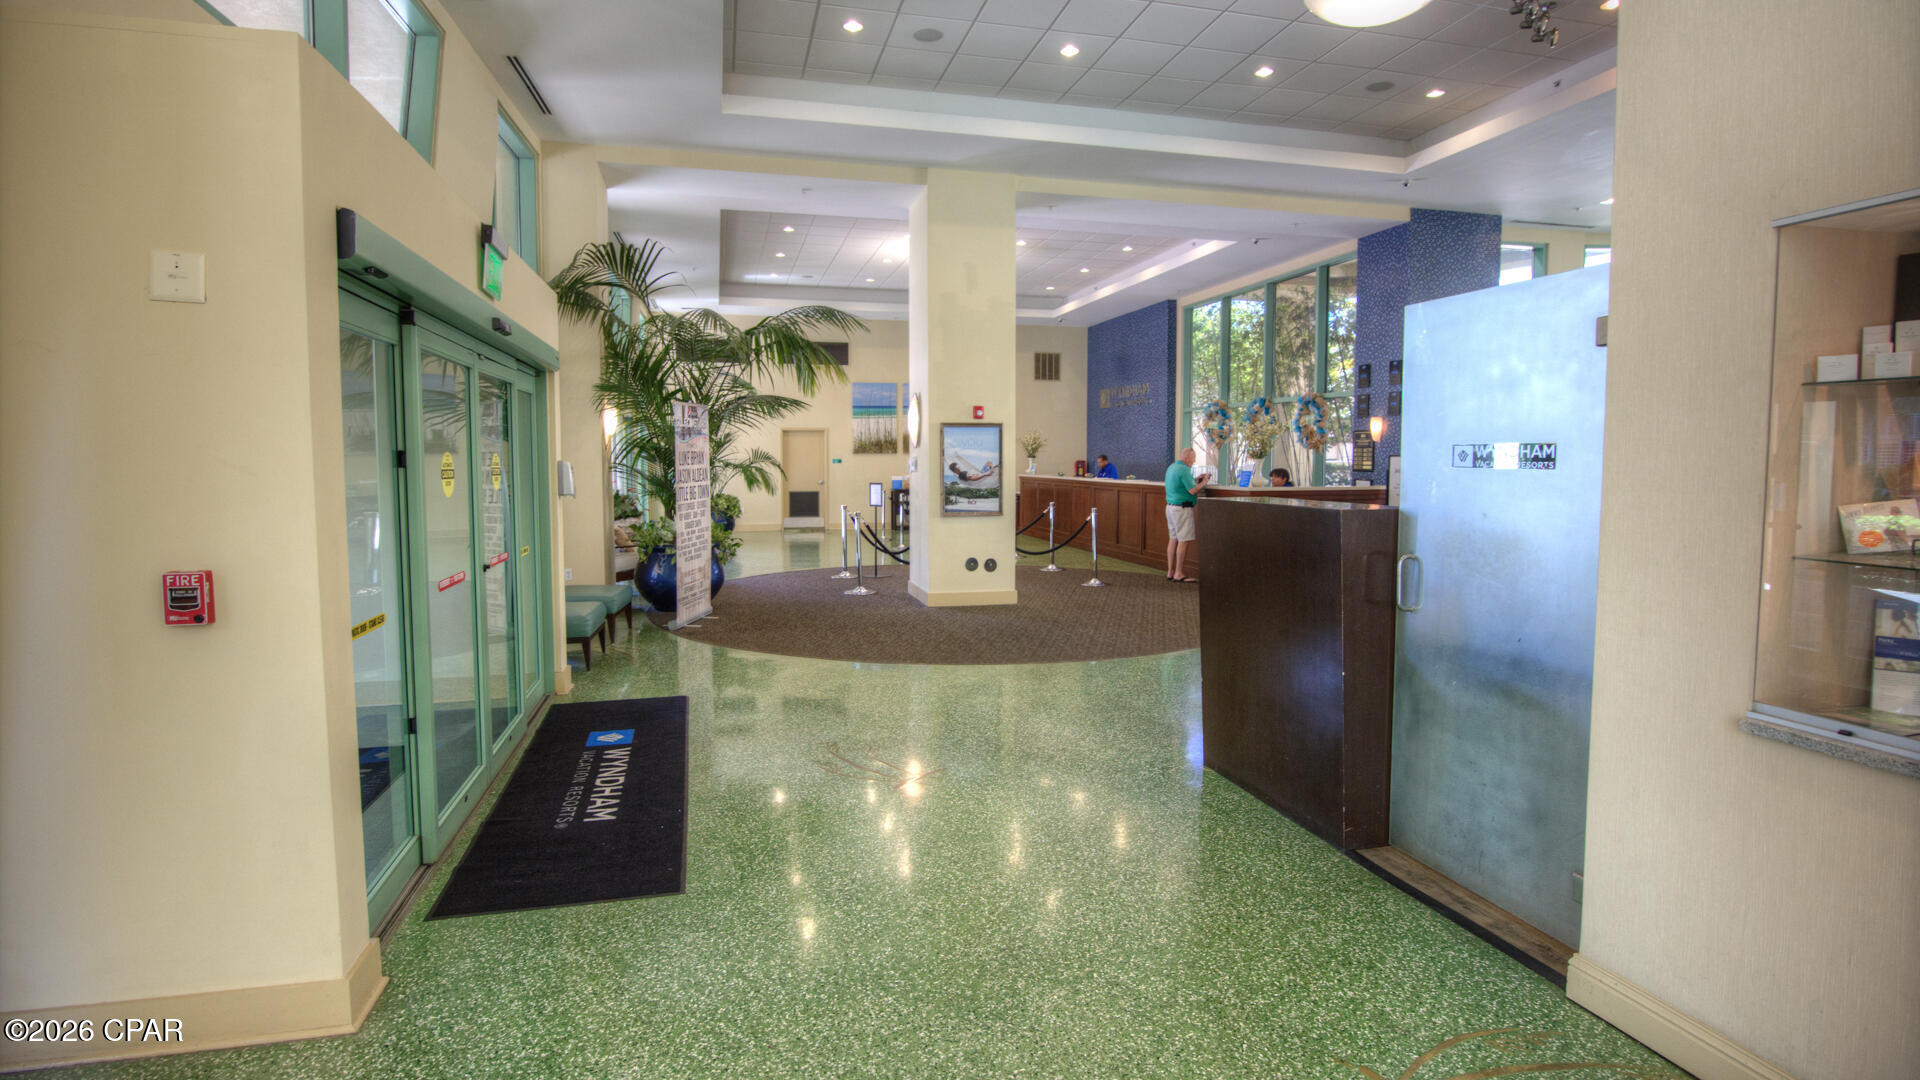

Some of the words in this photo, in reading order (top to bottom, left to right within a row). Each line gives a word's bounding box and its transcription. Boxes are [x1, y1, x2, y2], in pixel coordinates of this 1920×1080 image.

[1519, 461, 1555, 469] ESORTS
[166, 575, 201, 586] FIRE
[572, 749, 597, 783] VACATION
[583, 747, 632, 822] WYNDHAM
